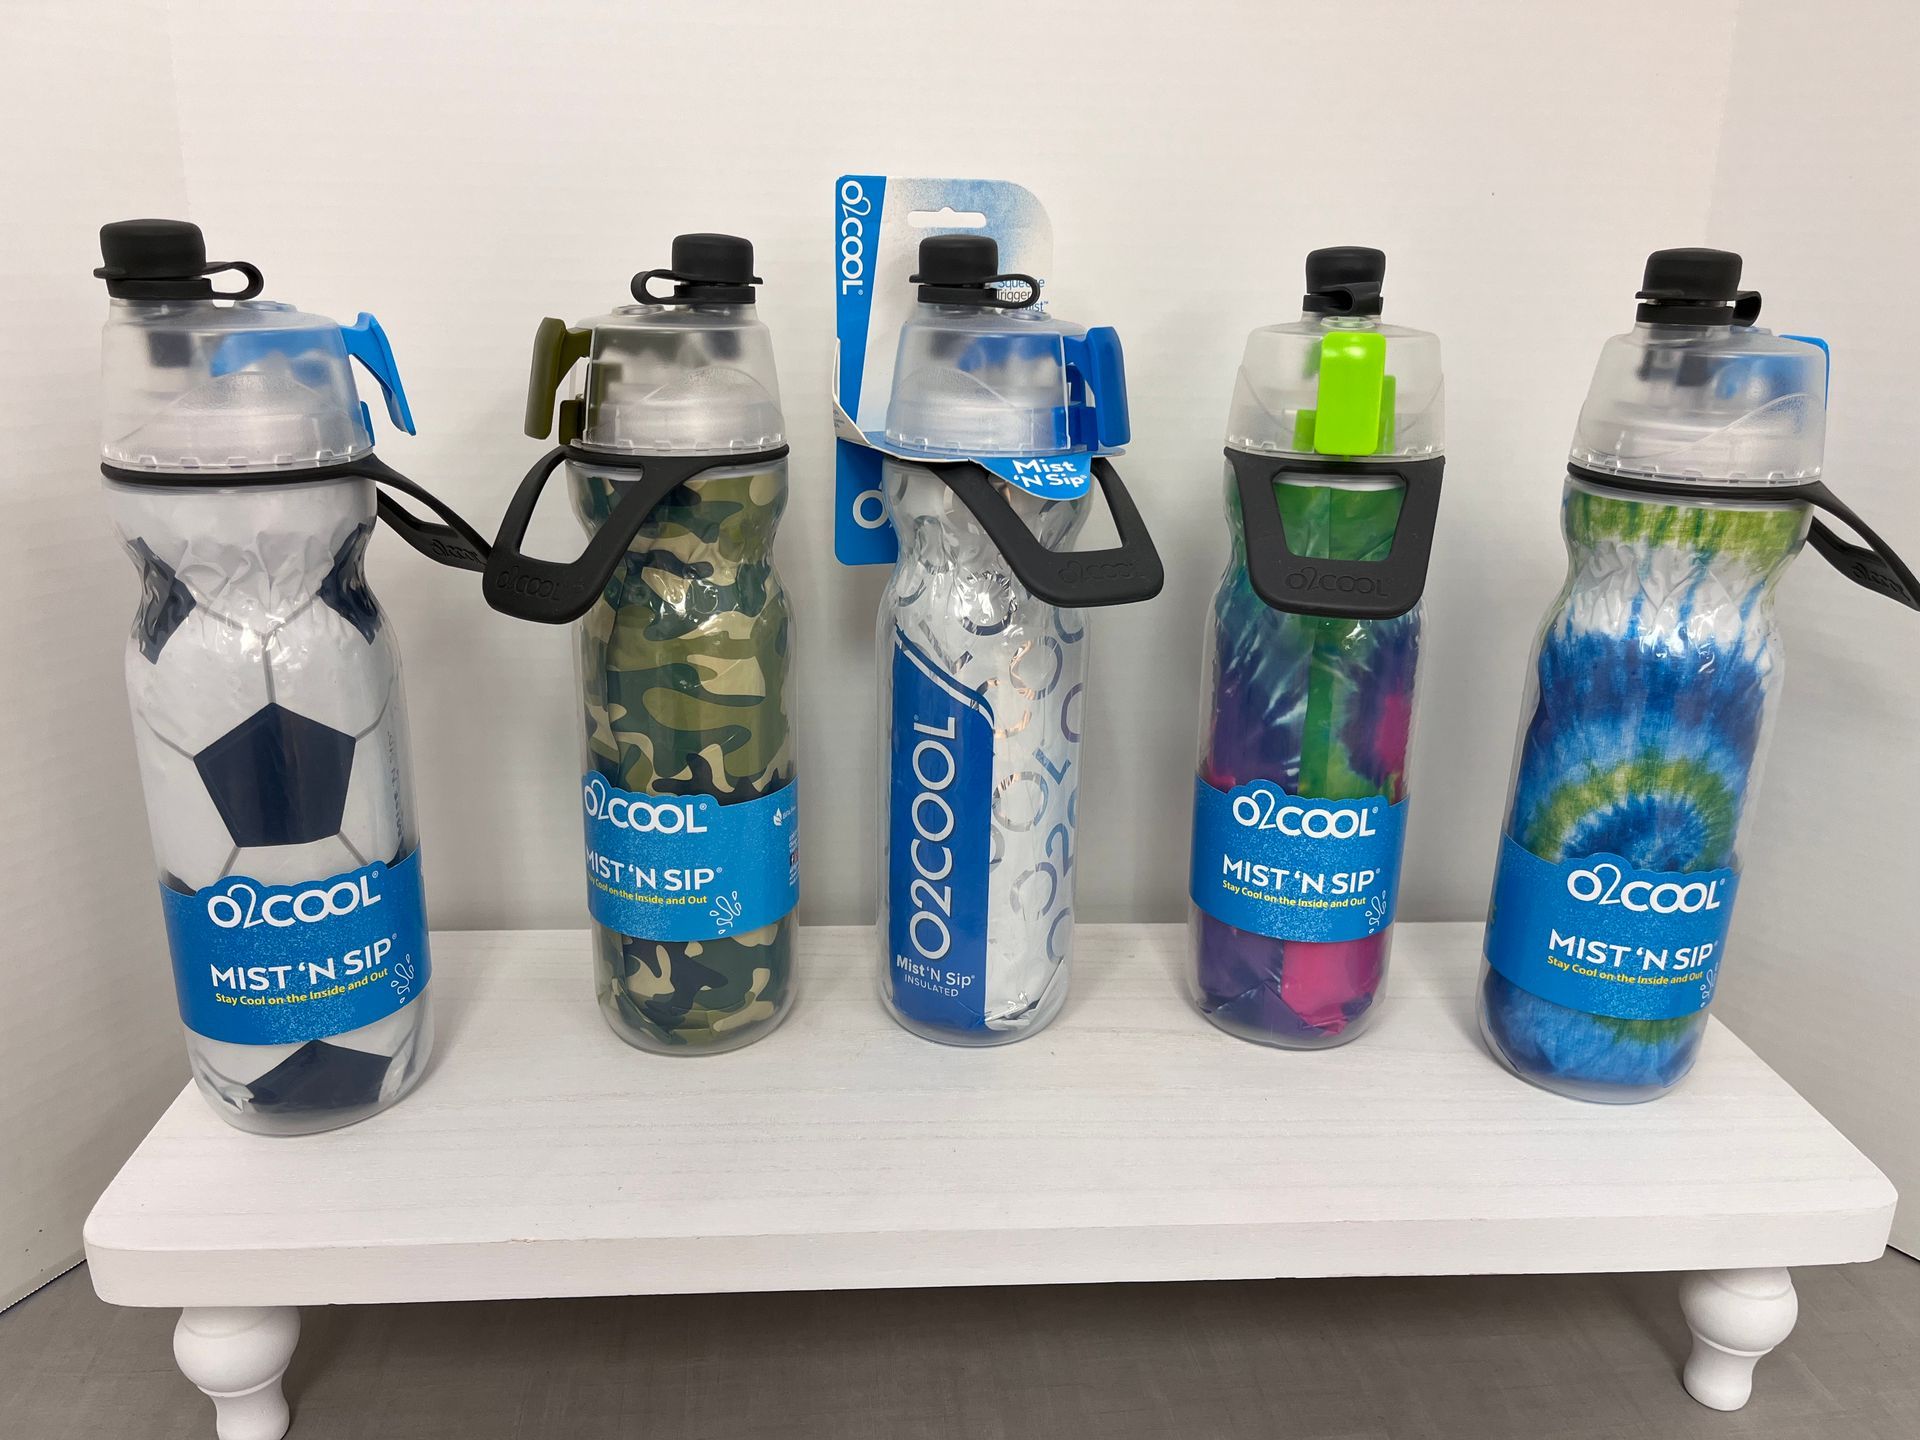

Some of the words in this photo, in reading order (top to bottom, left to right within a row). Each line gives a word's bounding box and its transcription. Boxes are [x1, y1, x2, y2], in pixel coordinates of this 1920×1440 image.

[1012, 459, 1077, 474] Mist
[586, 846, 625, 883] MIST
[1222, 854, 1290, 890] MIST
[608, 888, 619, 896] on
[619, 889, 634, 900] the
[635, 893, 664, 904] Inside
[666, 896, 686, 905] and
[688, 896, 707, 904] Out
[1222, 880, 1240, 895] Stay
[1242, 887, 1262, 900] Cool
[1264, 894, 1278, 902] on
[1278, 894, 1296, 906] the
[1298, 898, 1328, 908] Inside
[1330, 898, 1348, 908] and
[1350, 897, 1366, 906] Out
[1549, 928, 1632, 968] MIST
[1672, 942, 1714, 970] SIP
[210, 964, 292, 991] MIST
[896, 954, 924, 977] Mist
[1548, 956, 1570, 971] Stay
[1572, 964, 1597, 978] Cool
[1600, 972, 1614, 980] on
[1616, 972, 1636, 984] the
[1638, 974, 1669, 985] Inside
[1670, 973, 1688, 984] and
[1689, 971, 1704, 981] Out
[216, 992, 238, 1006] Stay
[240, 995, 266, 1006] Cool
[268, 996, 284, 1005] on
[286, 993, 307, 1004] the
[310, 985, 346, 1000] Inside
[348, 976, 368, 990] and
[370, 968, 388, 982] Out
[904, 974, 959, 997] INSULATED
